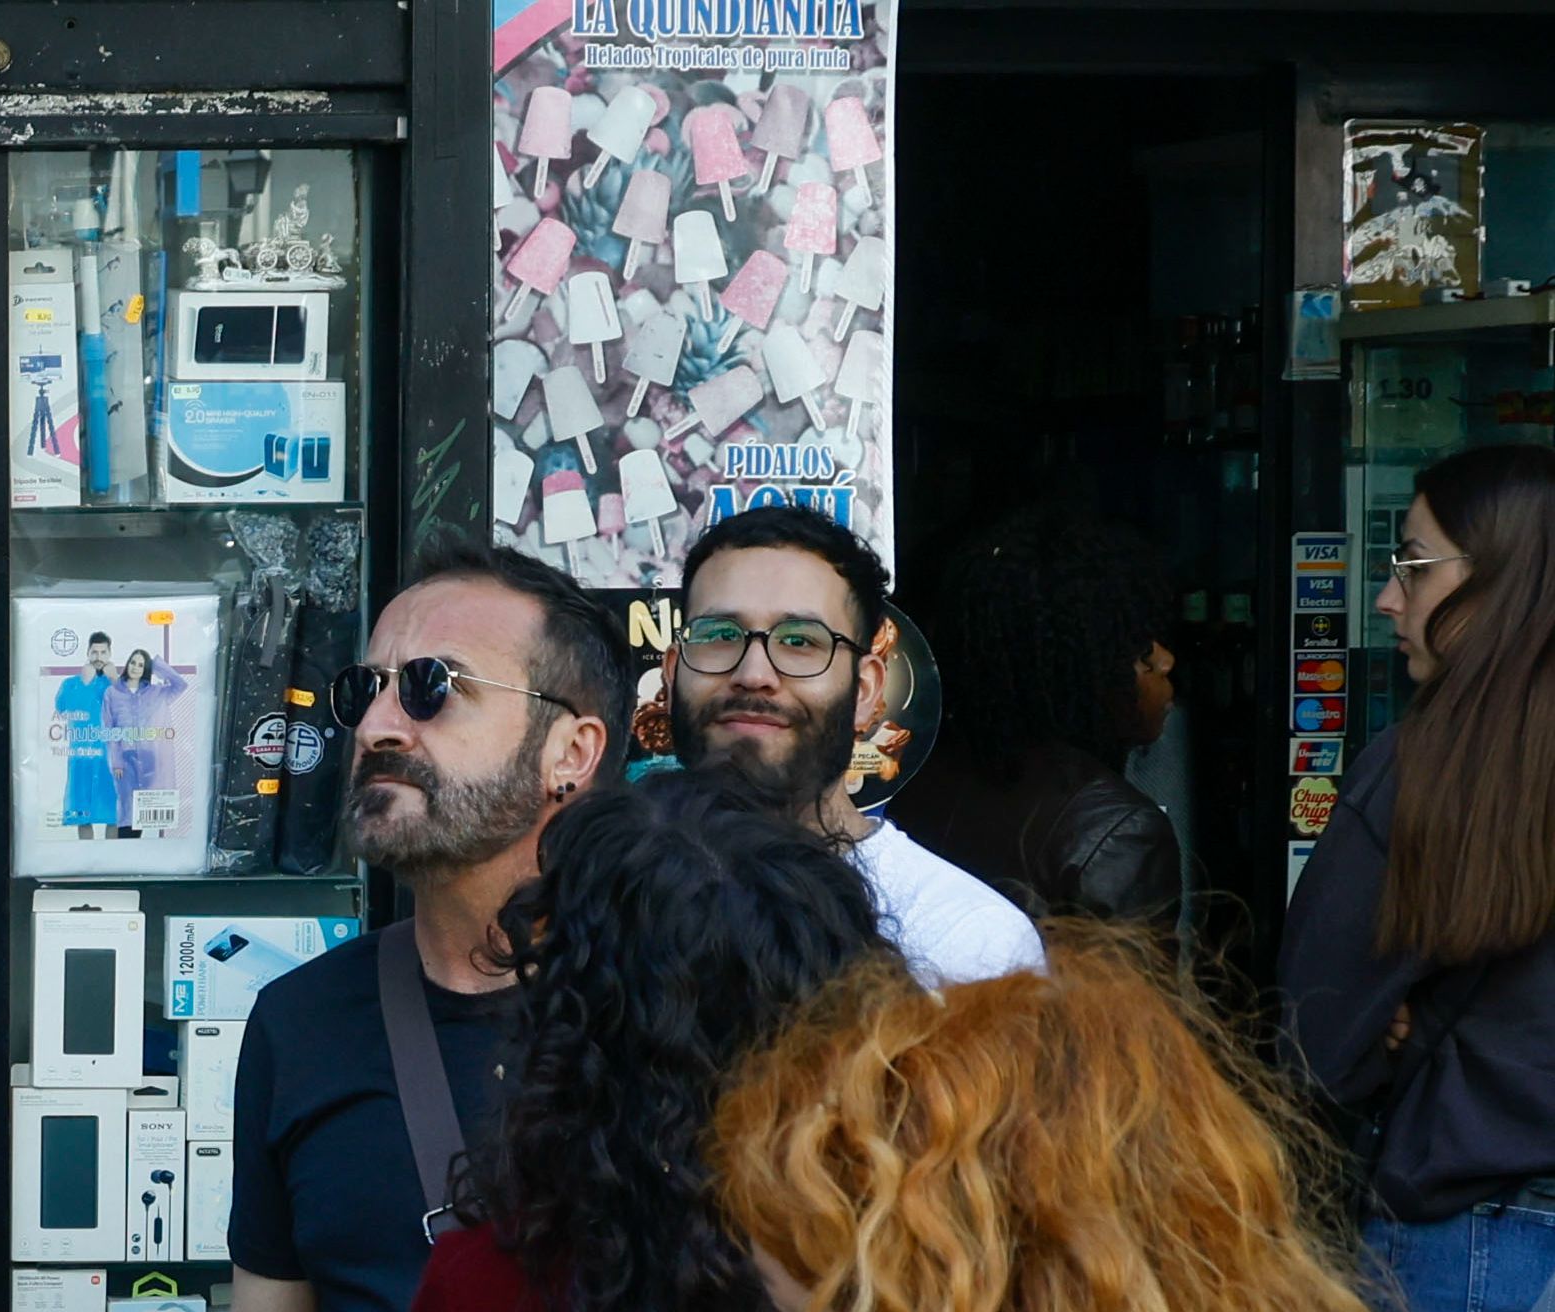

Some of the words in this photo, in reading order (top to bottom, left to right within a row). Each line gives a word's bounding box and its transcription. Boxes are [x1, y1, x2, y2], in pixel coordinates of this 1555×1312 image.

[572, 0, 617, 37] LA
[586, 43, 651, 68] Helados
[656, 45, 738, 71] Tropicales
[742, 46, 761, 69] de
[765, 50, 804, 72] pura
[809, 48, 849, 70] fruta
[724, 438, 834, 479] PÍDALOS
[1304, 546, 1339, 560] VISA
[1309, 579, 1334, 590] VISA
[1300, 597, 1343, 607] Electron
[1297, 671, 1344, 682] MasterCard
[1301, 708, 1341, 719] Maestro
[49, 724, 176, 745] Chubasquero
[179, 922, 195, 976] 12000mAh
[140, 1122, 174, 1131] SONY
